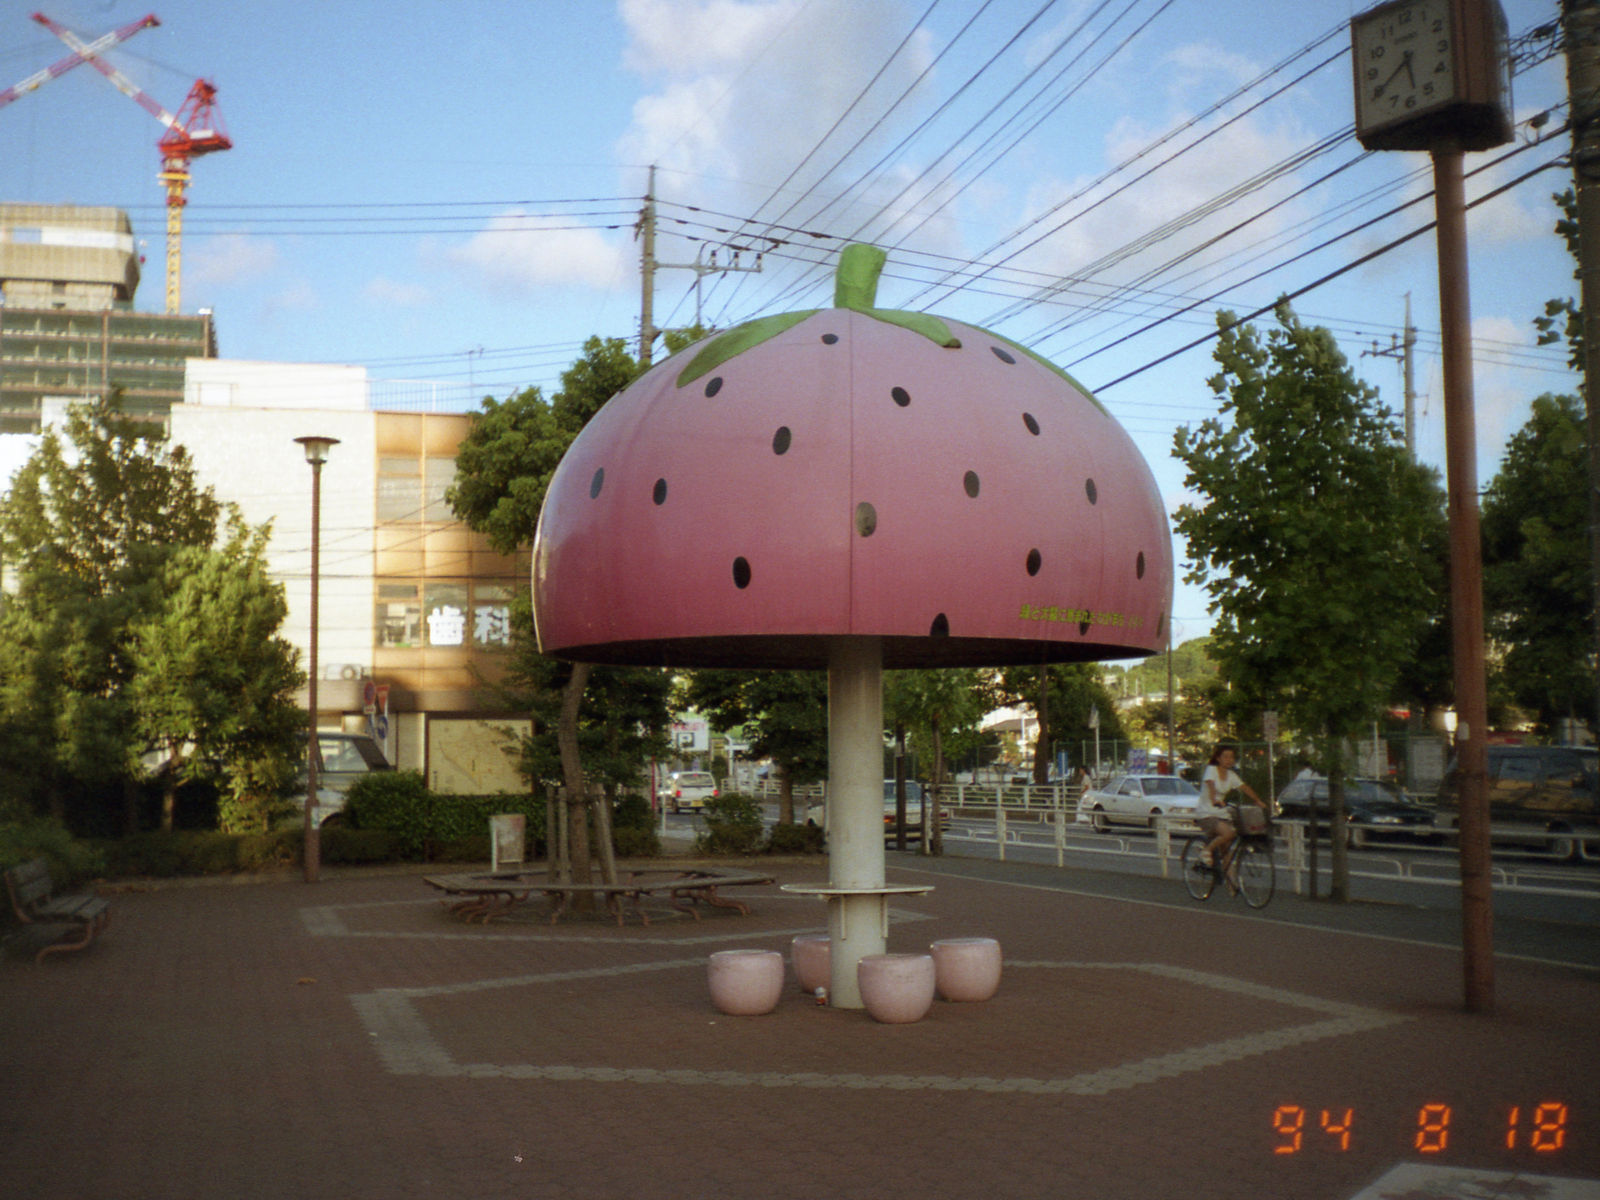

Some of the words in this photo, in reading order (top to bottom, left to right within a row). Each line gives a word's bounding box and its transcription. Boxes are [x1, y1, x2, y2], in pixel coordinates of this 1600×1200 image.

[1381, 24, 1393, 39] 11
[1432, 19, 1442, 32] 2
[1370, 46, 1385, 59] 10
[1438, 40, 1449, 53] 3
[1434, 61, 1447, 73] 4
[1367, 68, 1378, 80] 9
[1423, 81, 1434, 96] 5
[1390, 95, 1400, 108] 7
[1405, 96, 1416, 108] 6
[426, 604, 511, 646] 歯科
